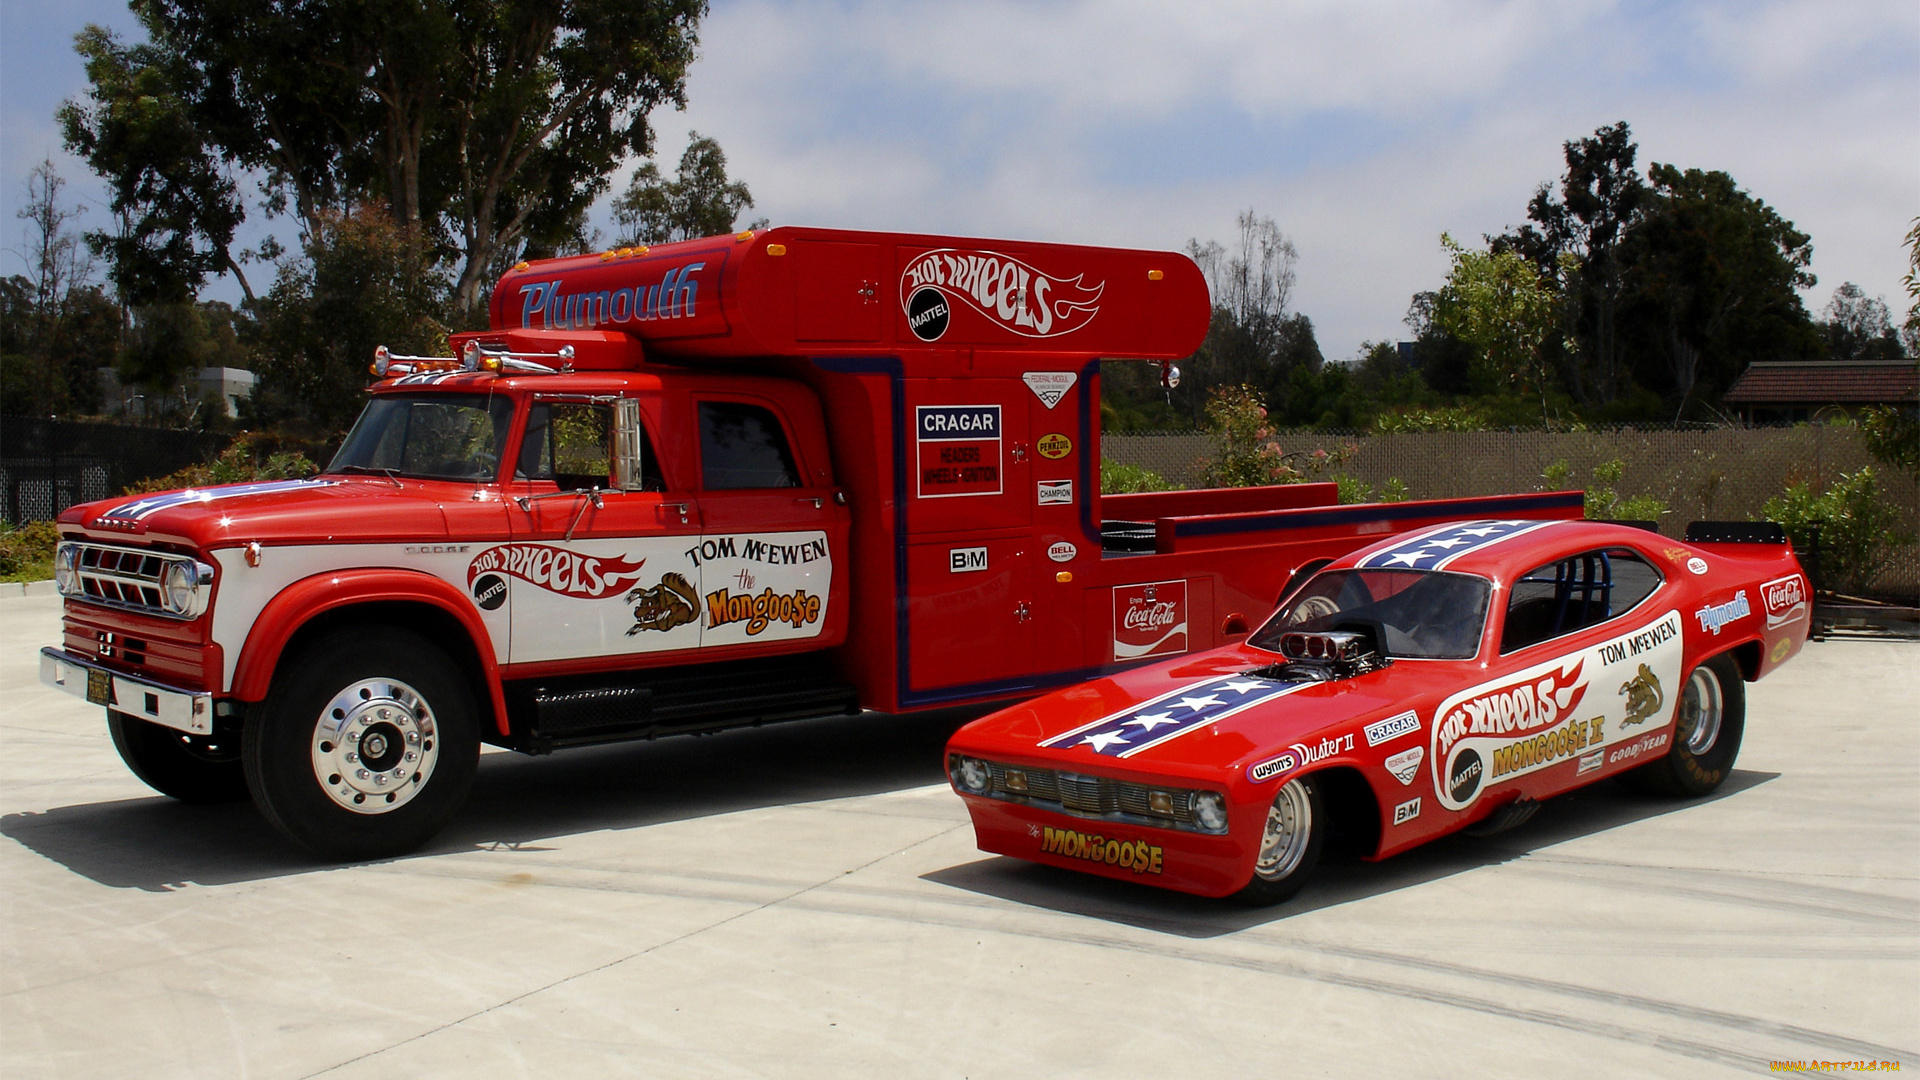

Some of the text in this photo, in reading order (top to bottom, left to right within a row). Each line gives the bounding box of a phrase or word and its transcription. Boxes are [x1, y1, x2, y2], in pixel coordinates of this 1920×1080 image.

[519, 262, 706, 330] Plymouth
[906, 254, 1053, 334] HOT WHEELS
[911, 303, 948, 328] MATTEL
[924, 413, 994, 431] CRAGAR
[941, 447, 980, 464] HEADERS
[1040, 488, 1071, 498] CHAMPION
[685, 537, 827, 568] TOM McEWEN
[1051, 546, 1074, 554] BELL
[471, 546, 605, 596] HOT WHEELS
[733, 568, 756, 590] the
[475, 581, 507, 604] MATTEL
[1124, 601, 1177, 629] Coca-Cola
[1695, 590, 1751, 635] Plymouth
[1598, 618, 1677, 666] TOM McEWEN
[1370, 716, 1416, 741] CRAGAR
[1439, 676, 1558, 755] HOT WHEELS
[1589, 716, 1605, 745] II
[1288, 733, 1354, 766] Duster II
[1450, 760, 1482, 791] MATTEL
